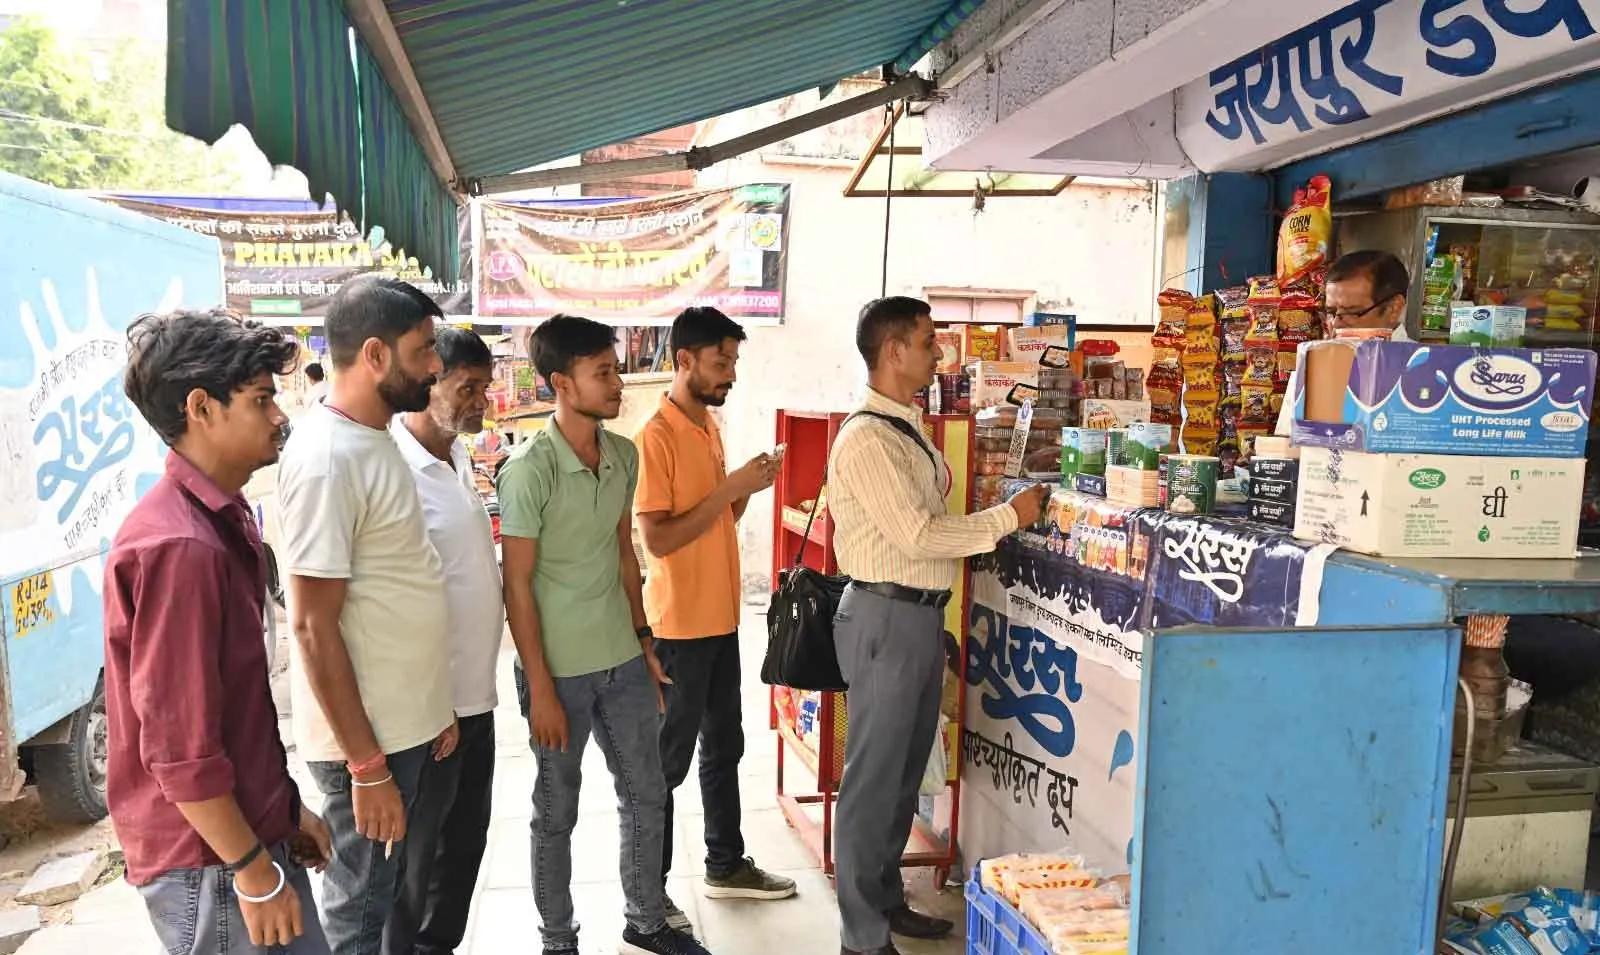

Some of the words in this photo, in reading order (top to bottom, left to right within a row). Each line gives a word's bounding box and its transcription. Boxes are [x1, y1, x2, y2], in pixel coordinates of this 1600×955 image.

[1205, 0, 1404, 145] जयपुर
[220, 218, 243, 234] की
[246, 219, 285, 238] सबसे
[287, 218, 329, 240] पुरानी
[1289, 214, 1312, 229] CORN
[233, 241, 374, 267] PHATAKA
[1470, 361, 1526, 395] Saras
[1452, 415, 1473, 424] UHT
[1476, 415, 1531, 427] Processed
[1453, 428, 1480, 439] Long
[1482, 429, 1503, 438] Life
[1505, 429, 1528, 440] Milk
[1482, 486, 1508, 517] घी
[1164, 521, 1258, 602] सरस
[966, 603, 1082, 758] सरस
[1047, 767, 1079, 835] दूध
